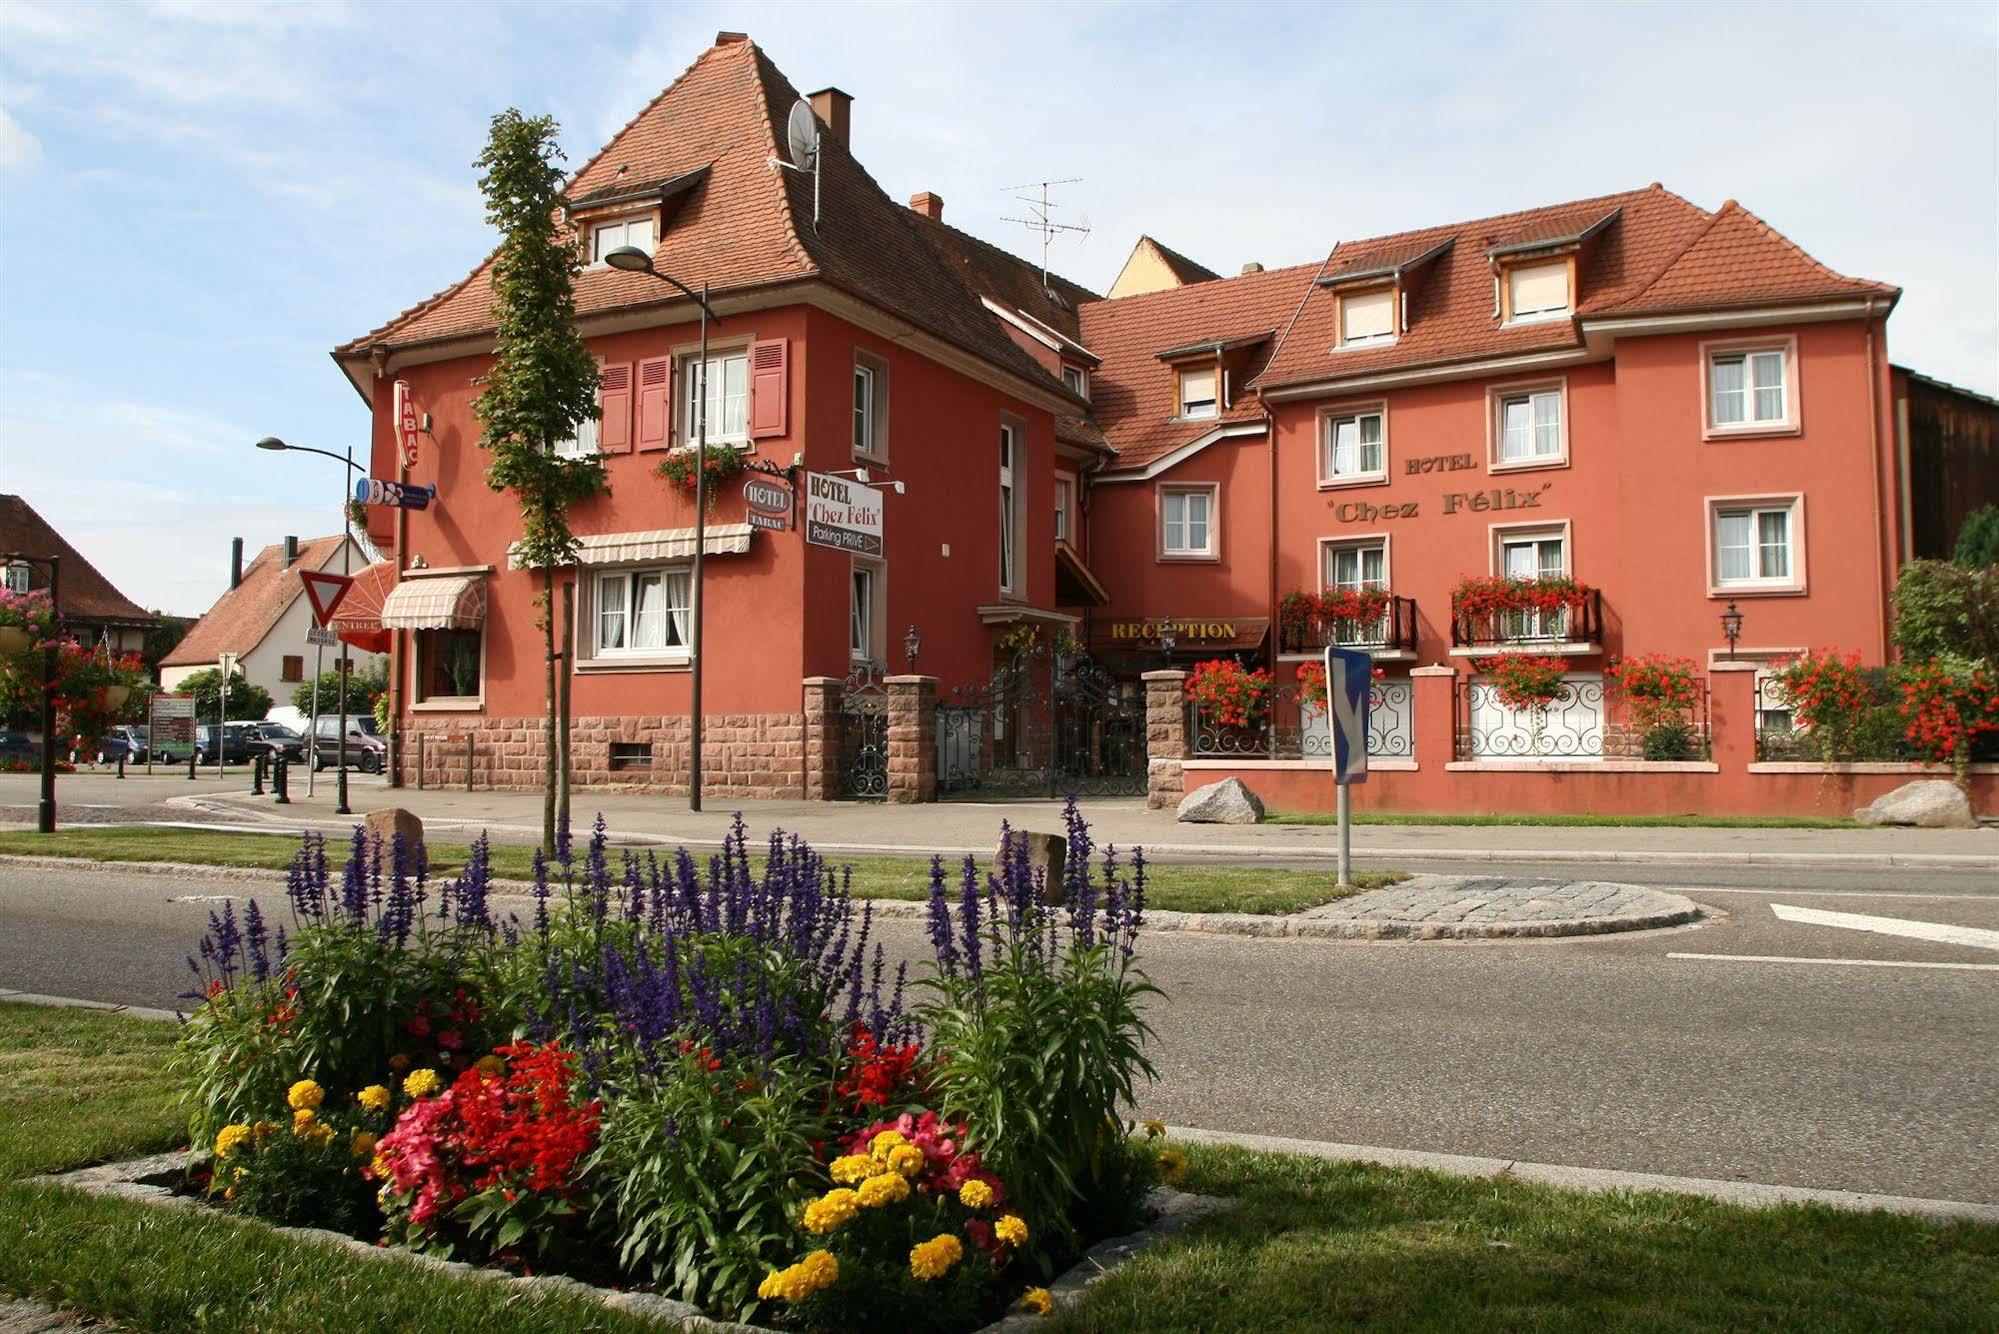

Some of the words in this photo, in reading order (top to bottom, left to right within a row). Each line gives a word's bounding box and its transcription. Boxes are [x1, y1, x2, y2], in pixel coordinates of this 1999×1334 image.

[402, 387, 418, 462] TABAC
[1405, 453, 1477, 475] HOTEL
[748, 486, 786, 509] HOTEL
[810, 475, 851, 504] HOTEL
[750, 515, 784, 529] TABAC
[813, 526, 841, 546] Parking
